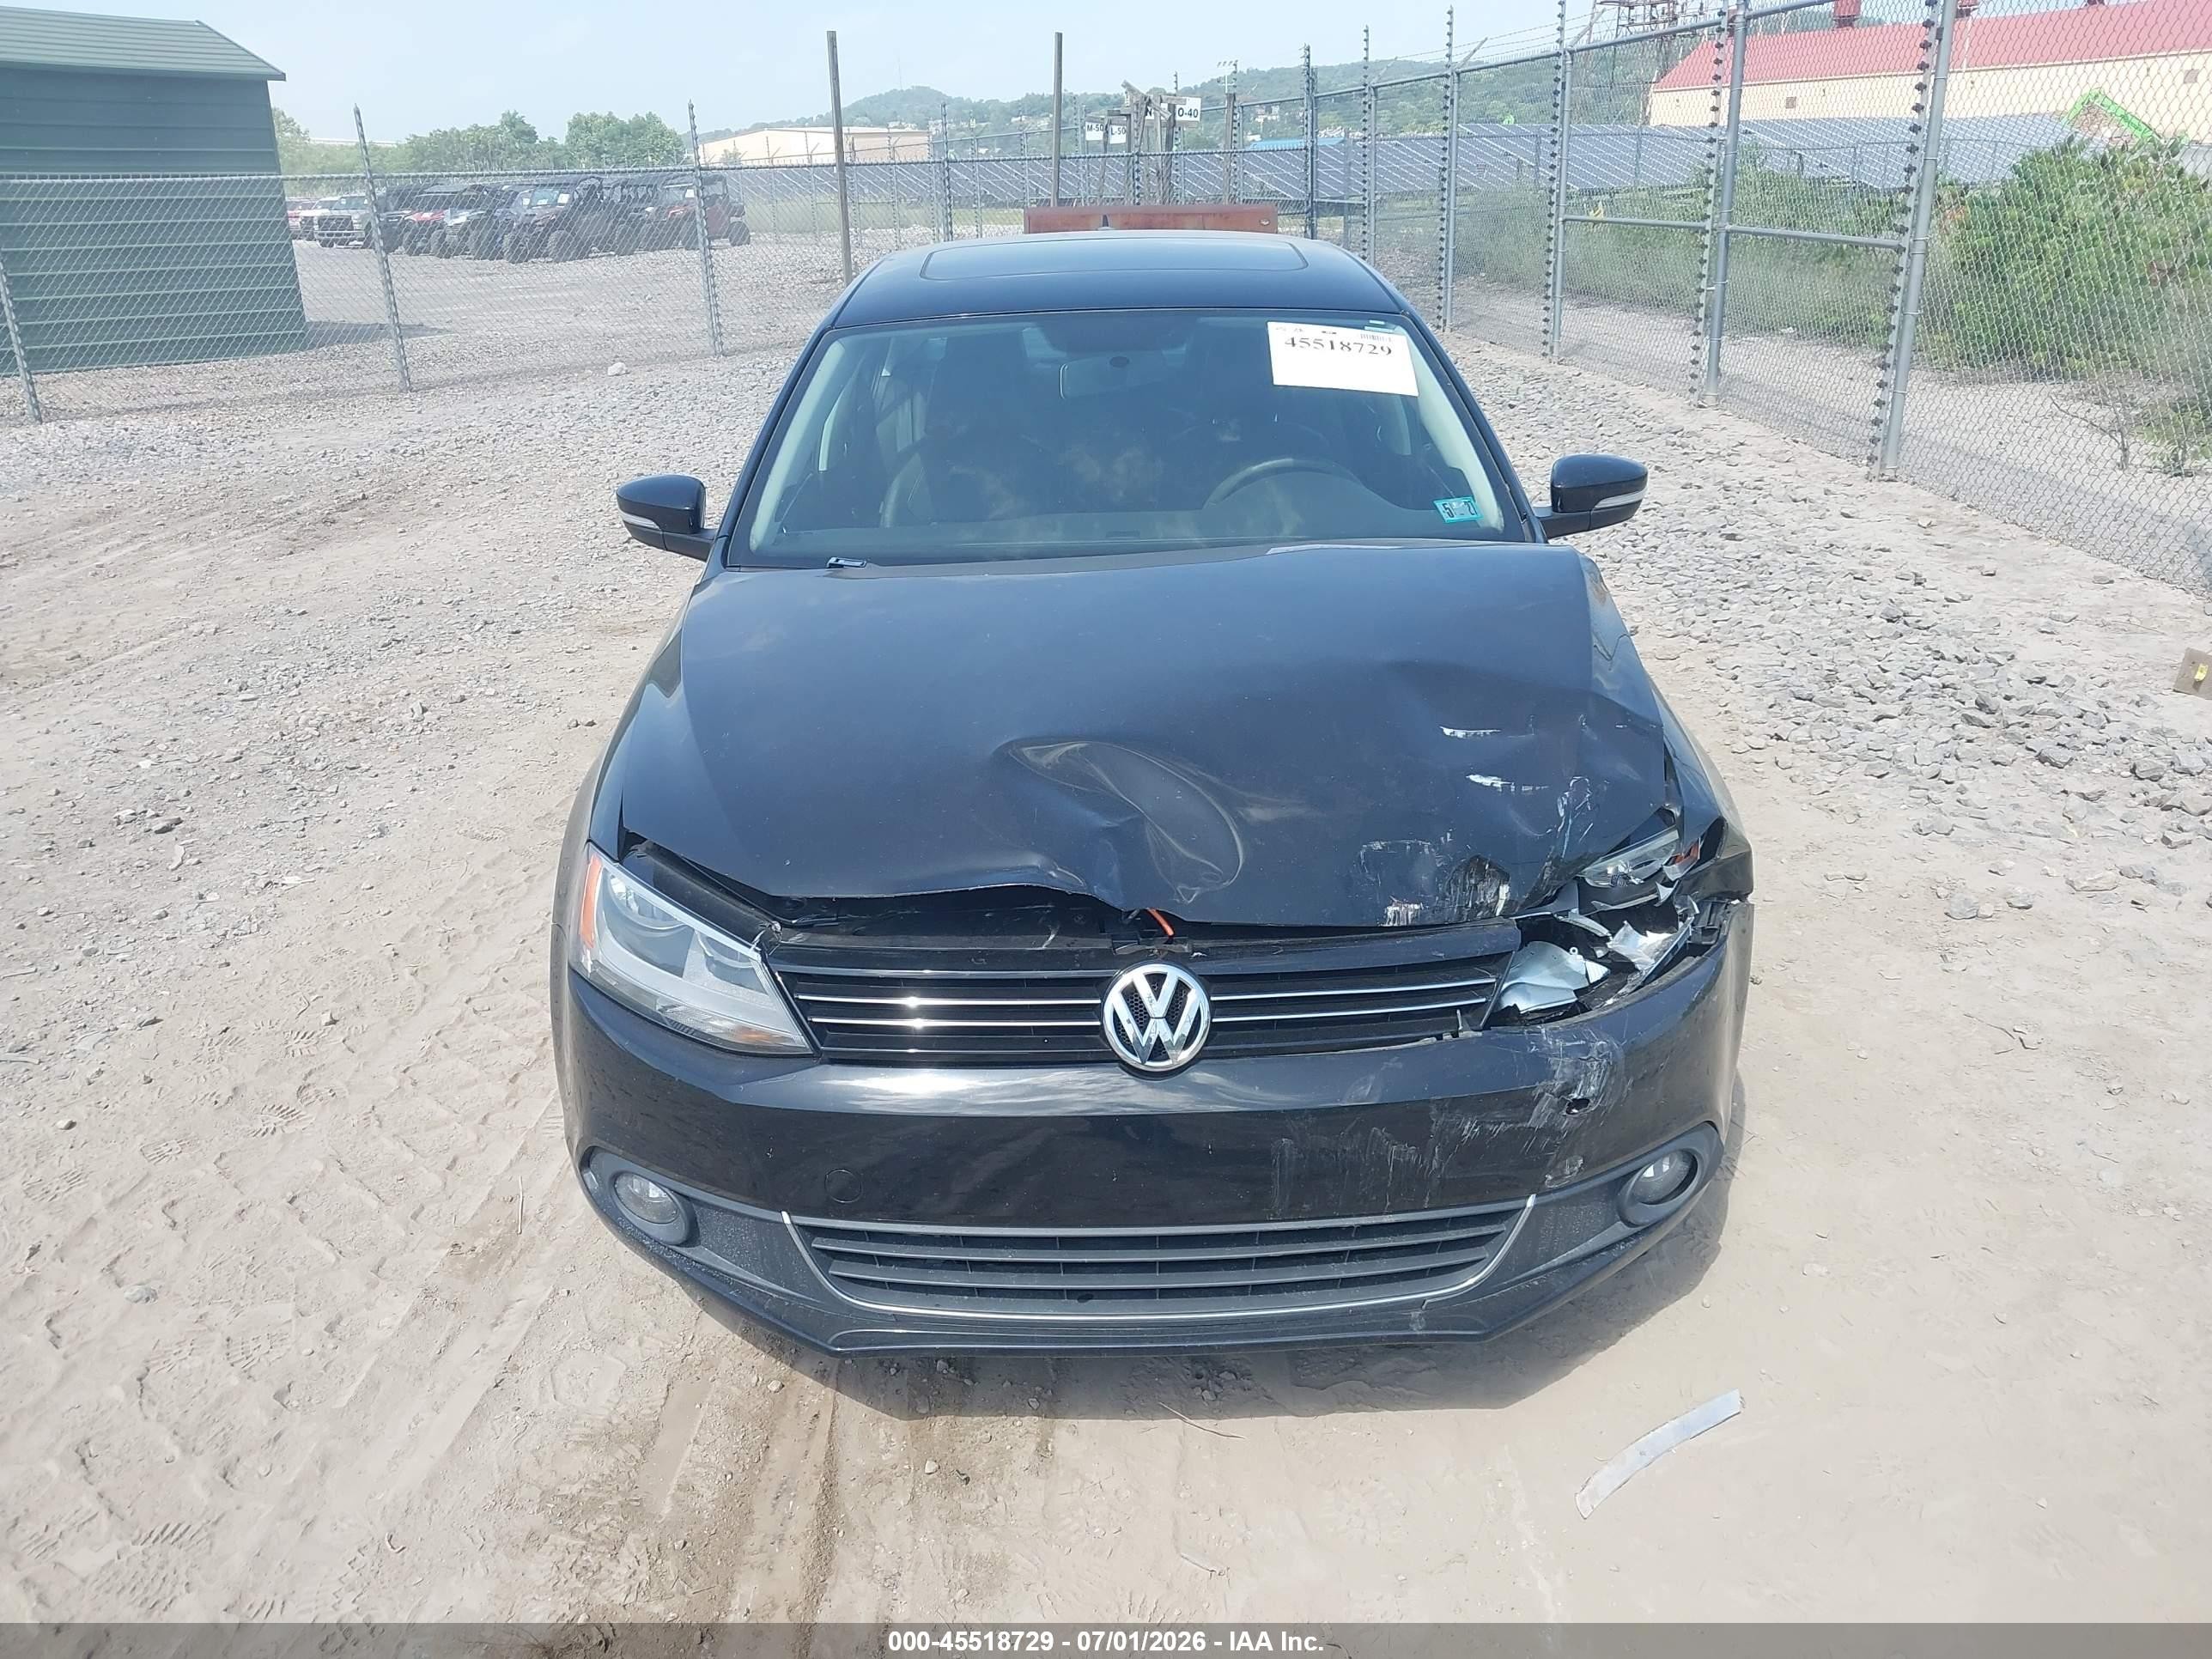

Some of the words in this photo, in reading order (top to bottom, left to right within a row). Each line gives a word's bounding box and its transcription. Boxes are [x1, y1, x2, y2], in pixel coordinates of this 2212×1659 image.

[1177, 106, 1199, 118] O-40
[1086, 124, 1104, 132] M-50
[1110, 126, 1127, 136] L-50
[1285, 337, 1392, 356] 45518729
